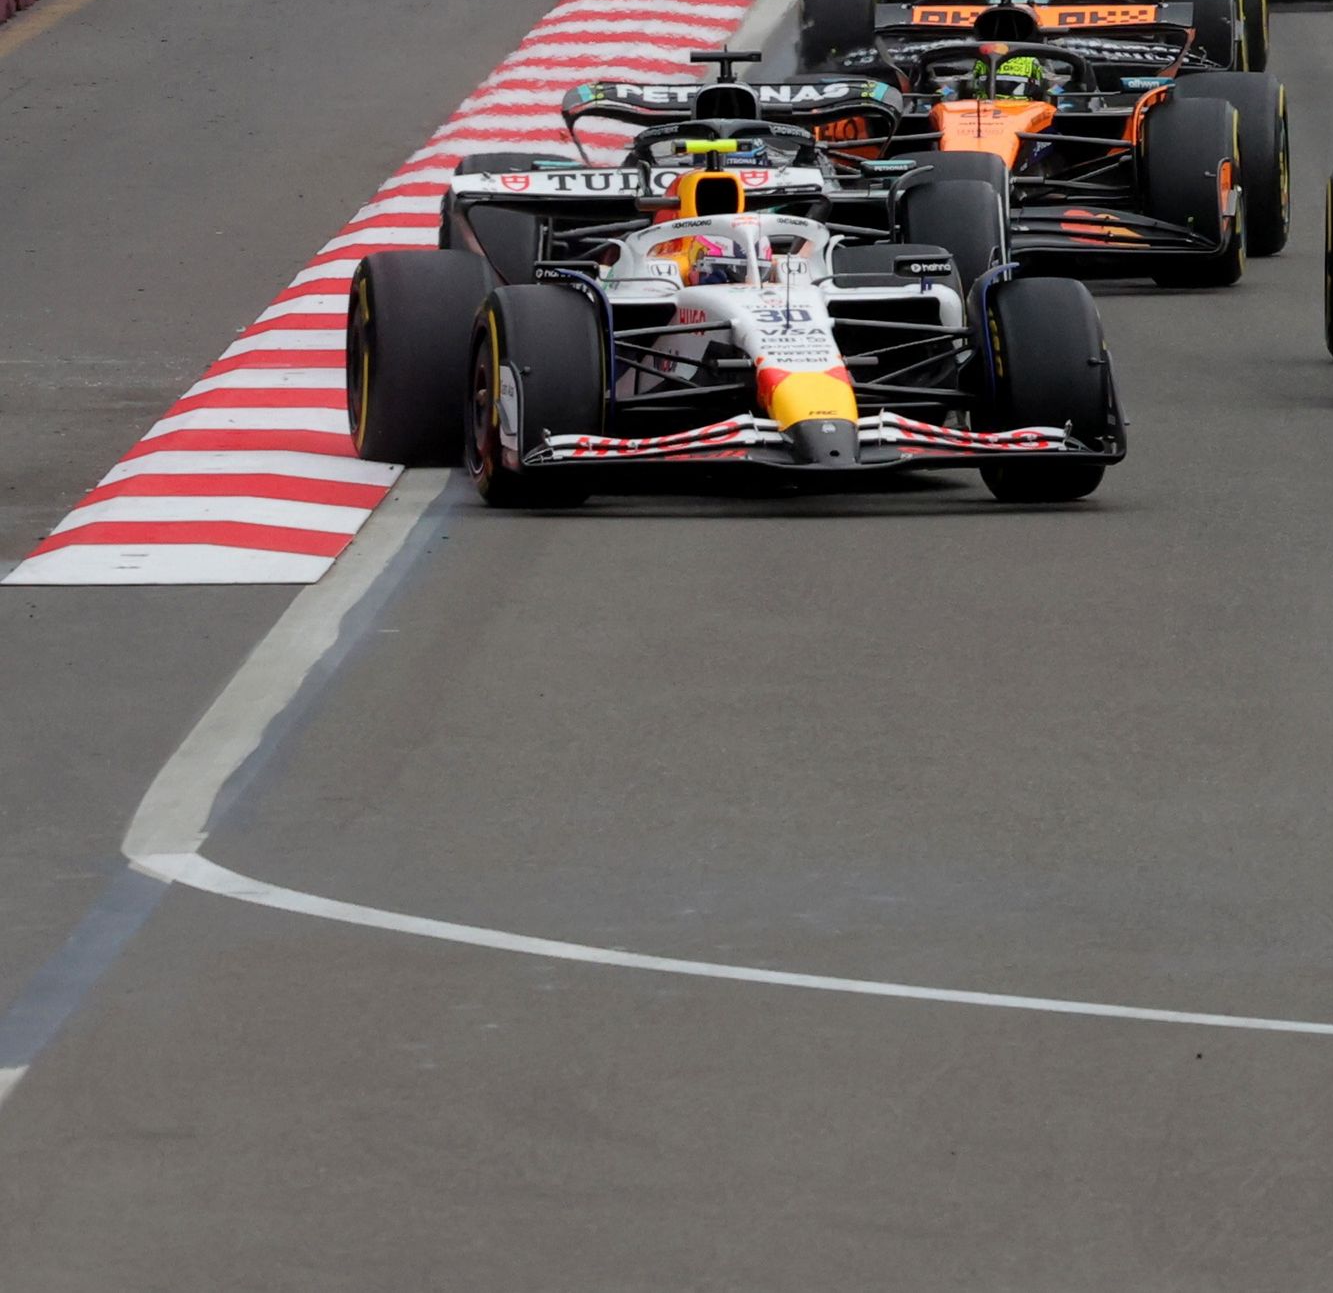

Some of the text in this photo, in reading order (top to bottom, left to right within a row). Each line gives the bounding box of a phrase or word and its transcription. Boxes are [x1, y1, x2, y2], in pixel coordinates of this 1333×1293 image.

[616, 83, 850, 104] PETNAS
[874, 164, 909, 172] PETRONAS
[751, 308, 812, 323] 30
[760, 328, 826, 336] VISA
